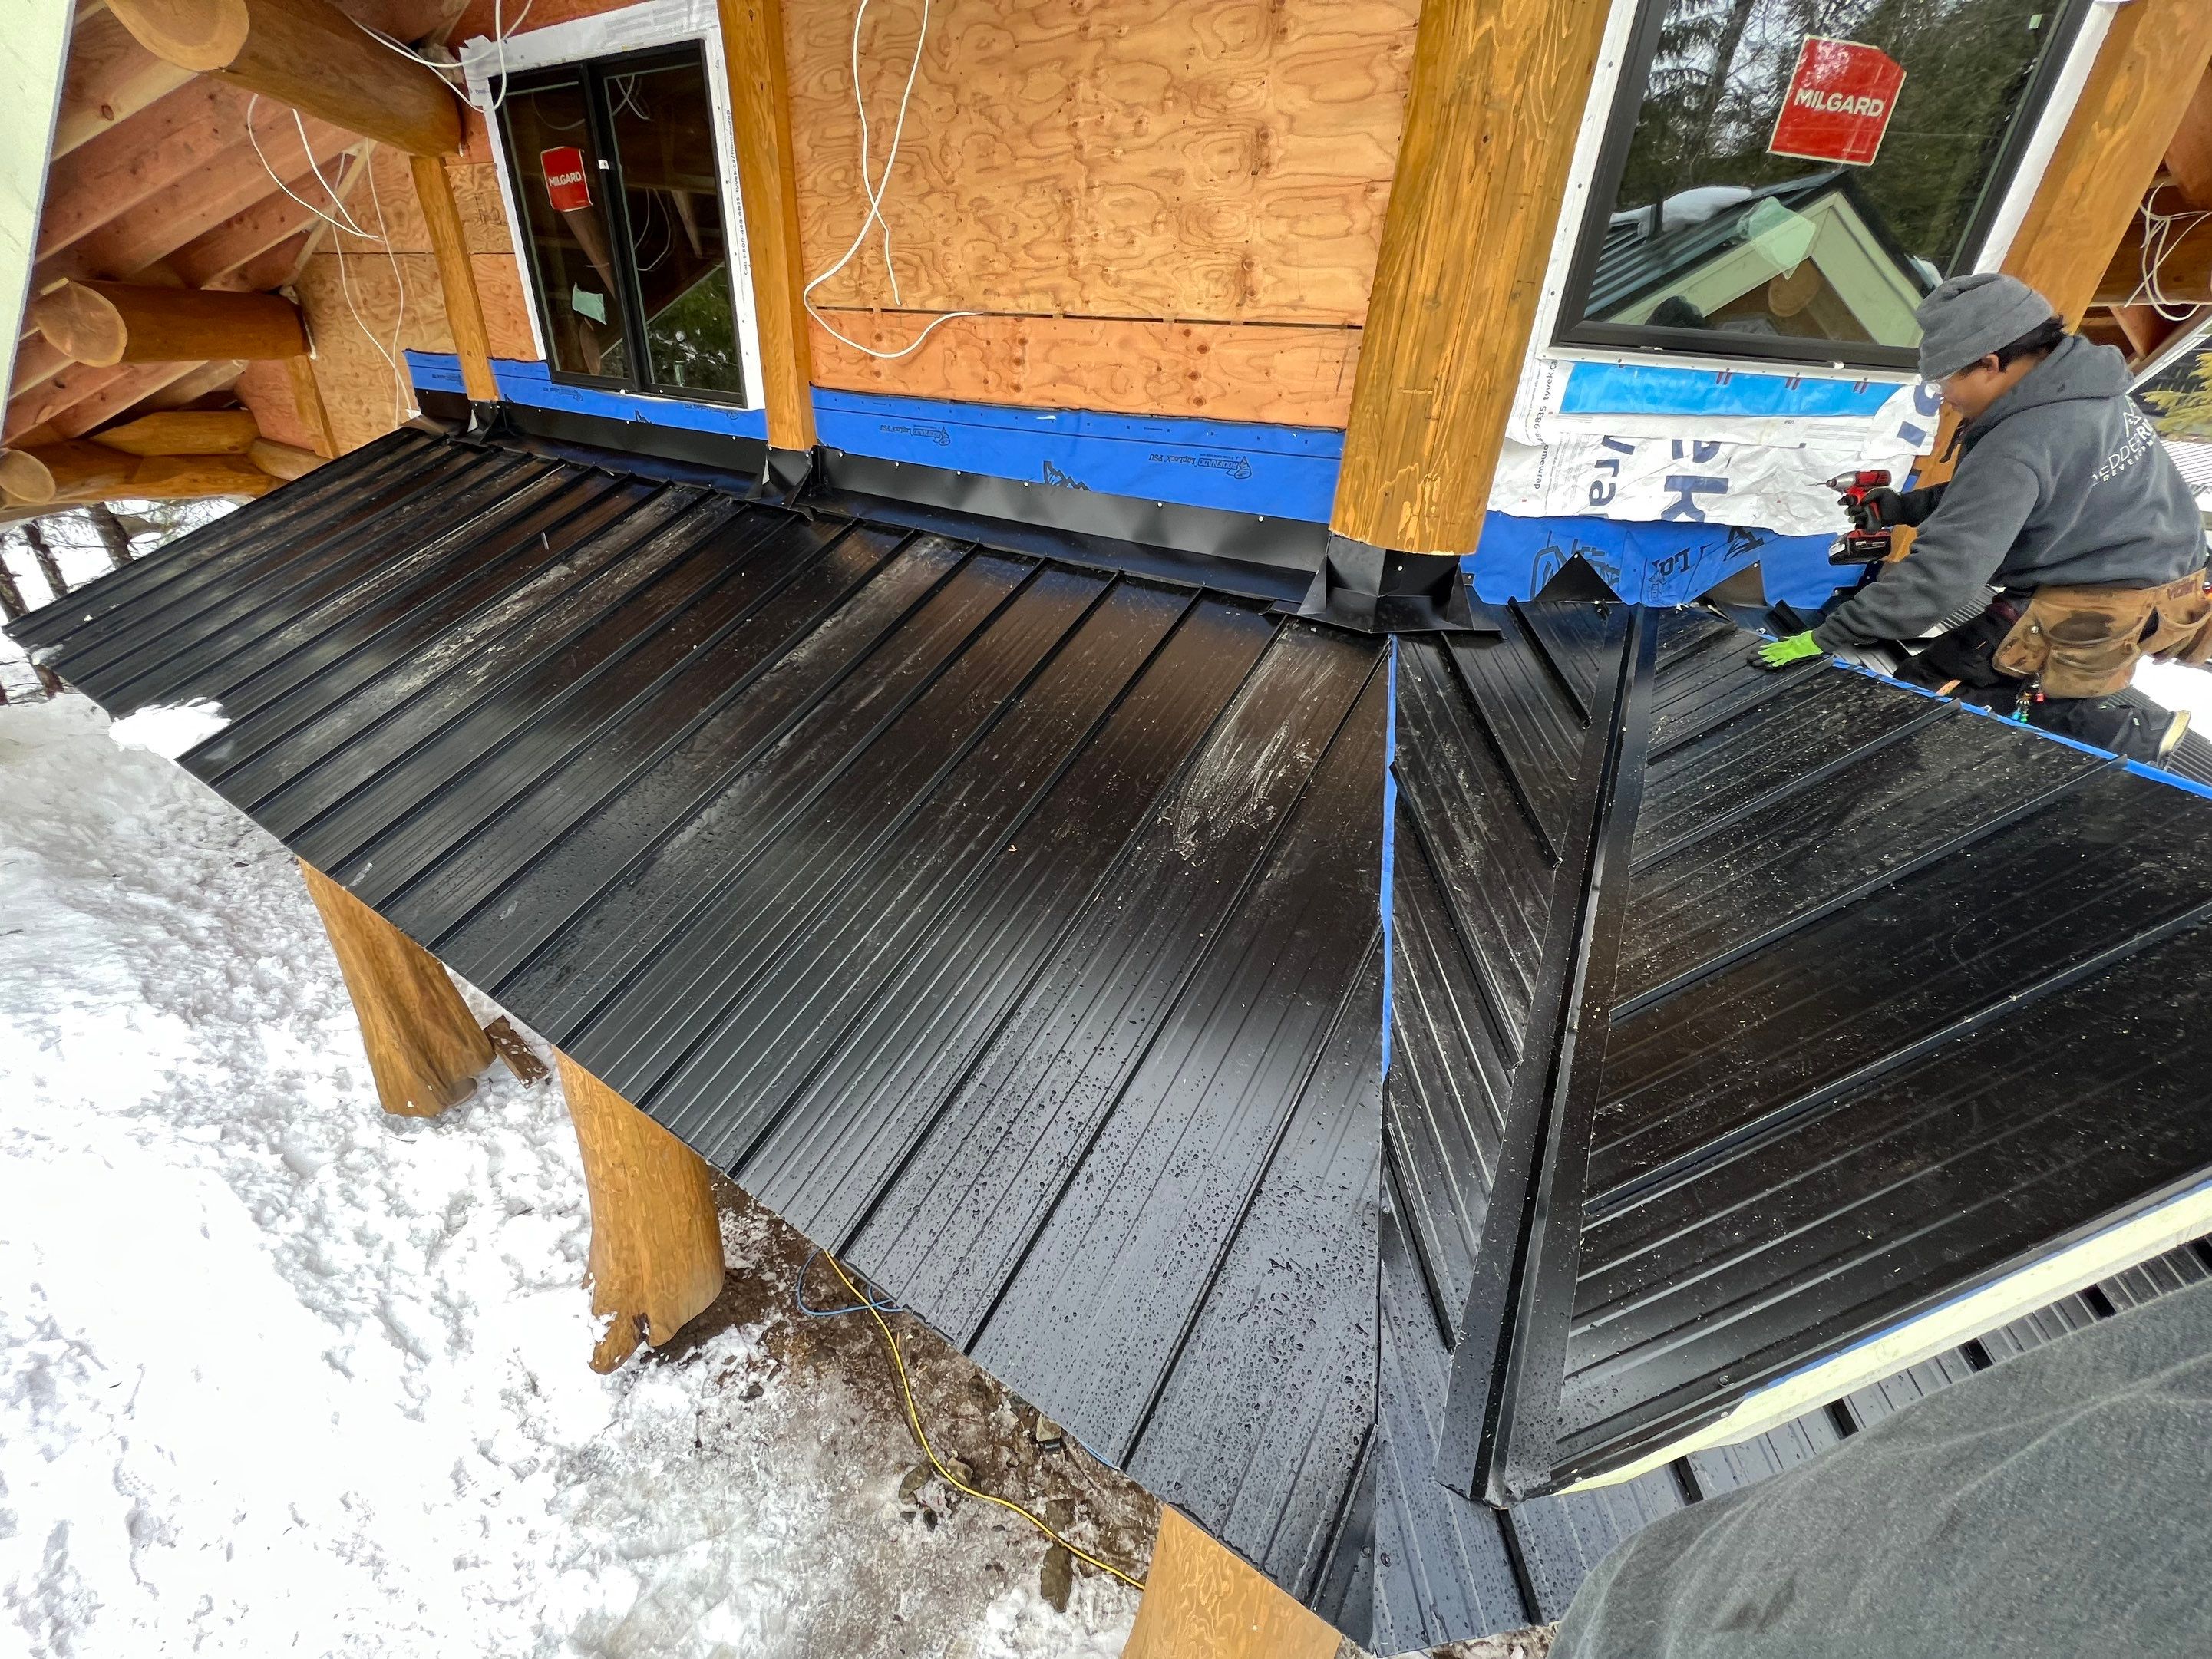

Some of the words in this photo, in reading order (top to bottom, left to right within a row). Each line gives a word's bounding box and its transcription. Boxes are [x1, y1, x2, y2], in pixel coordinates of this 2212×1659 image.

[1793, 87, 1885, 117] MILGARD
[548, 171, 582, 186] MILGARD
[1198, 458, 1239, 470] ROOFNADO
